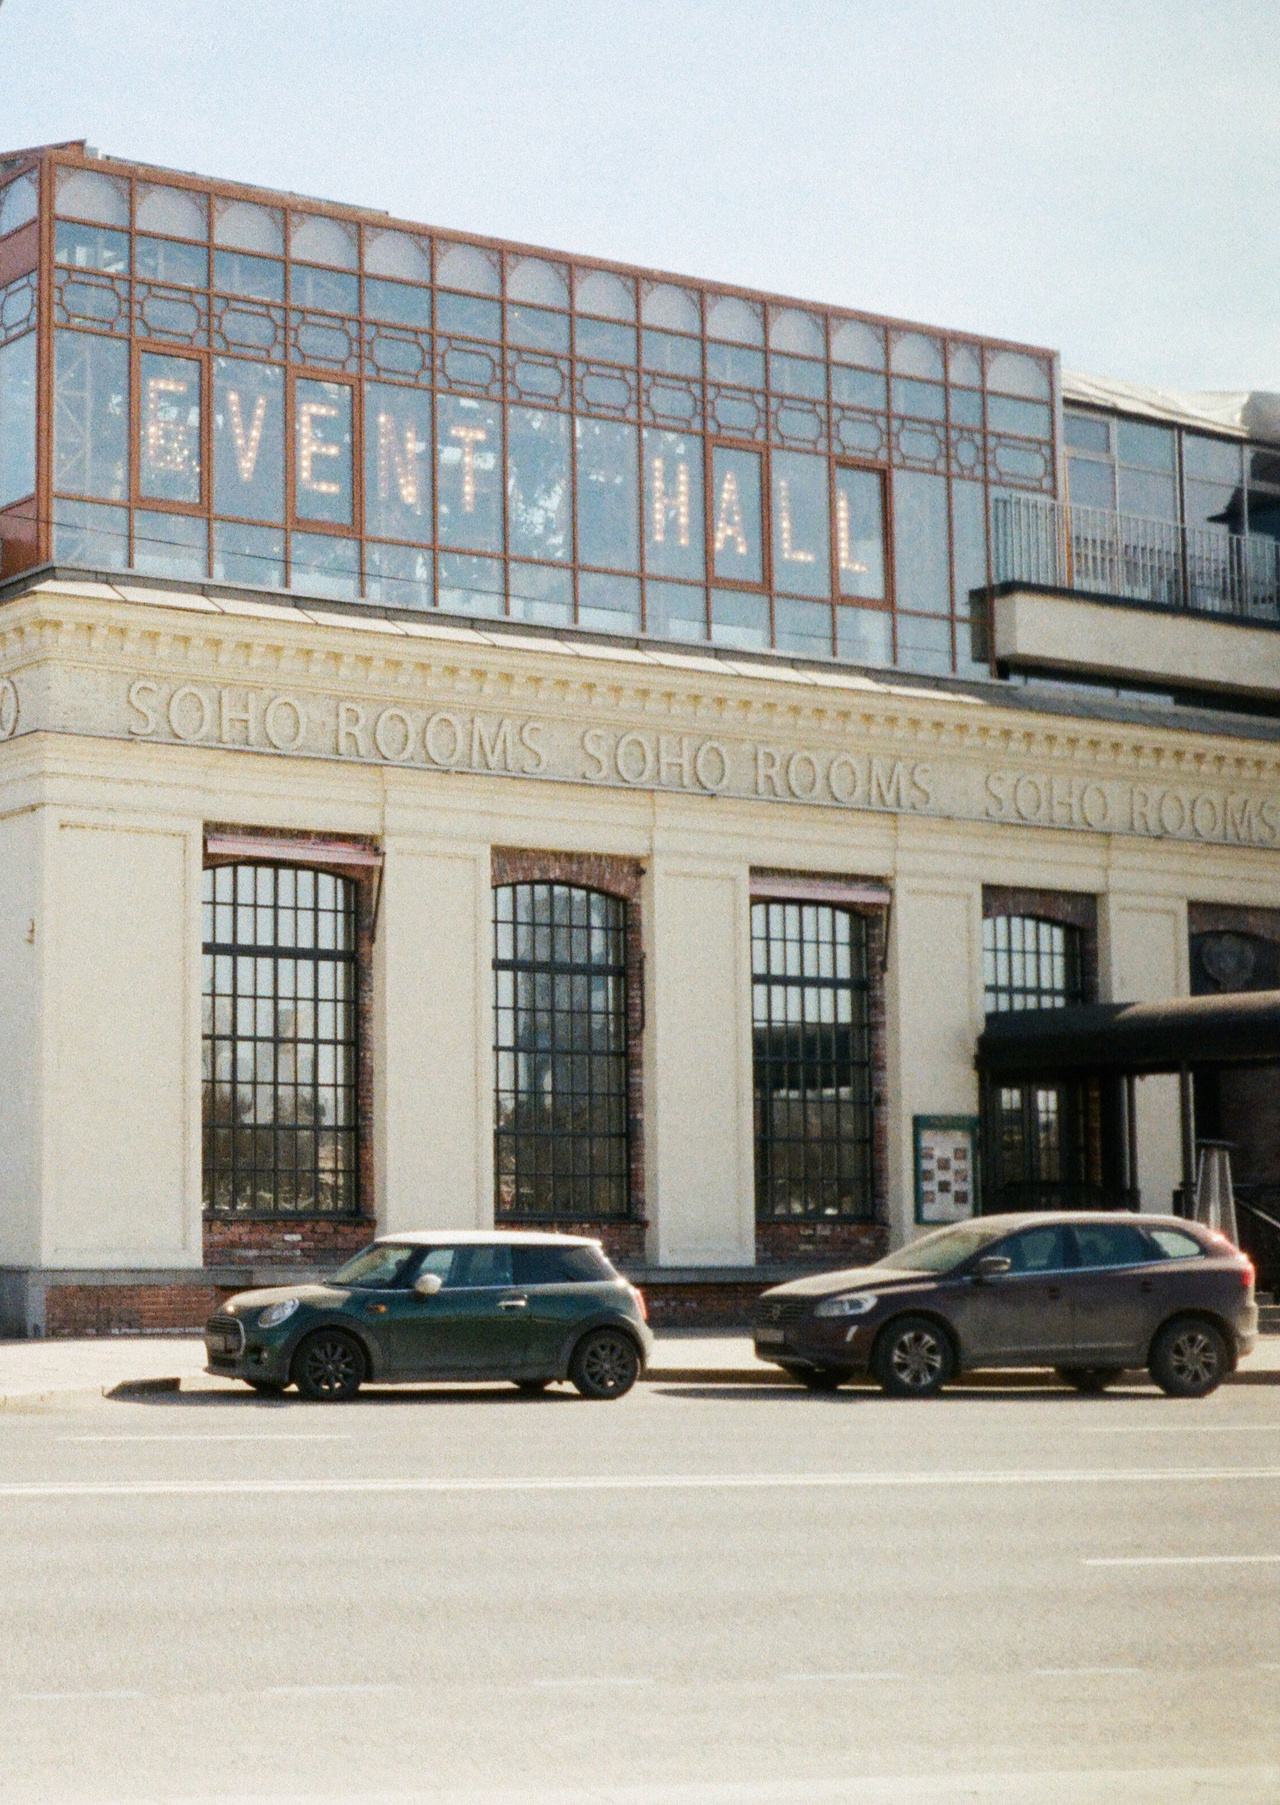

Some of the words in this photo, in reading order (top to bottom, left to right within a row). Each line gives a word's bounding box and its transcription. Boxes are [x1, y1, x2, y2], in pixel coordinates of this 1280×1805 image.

[147, 378, 487, 512] EVENT
[651, 457, 869, 573] HALL
[127, 679, 308, 751] SOHO
[336, 699, 550, 774] ROOMS
[580, 728, 731, 791] SOHO
[753, 743, 933, 809] ROOMS
[984, 773, 1108, 828] SOHO
[1129, 786, 1279, 845] ROOMS
